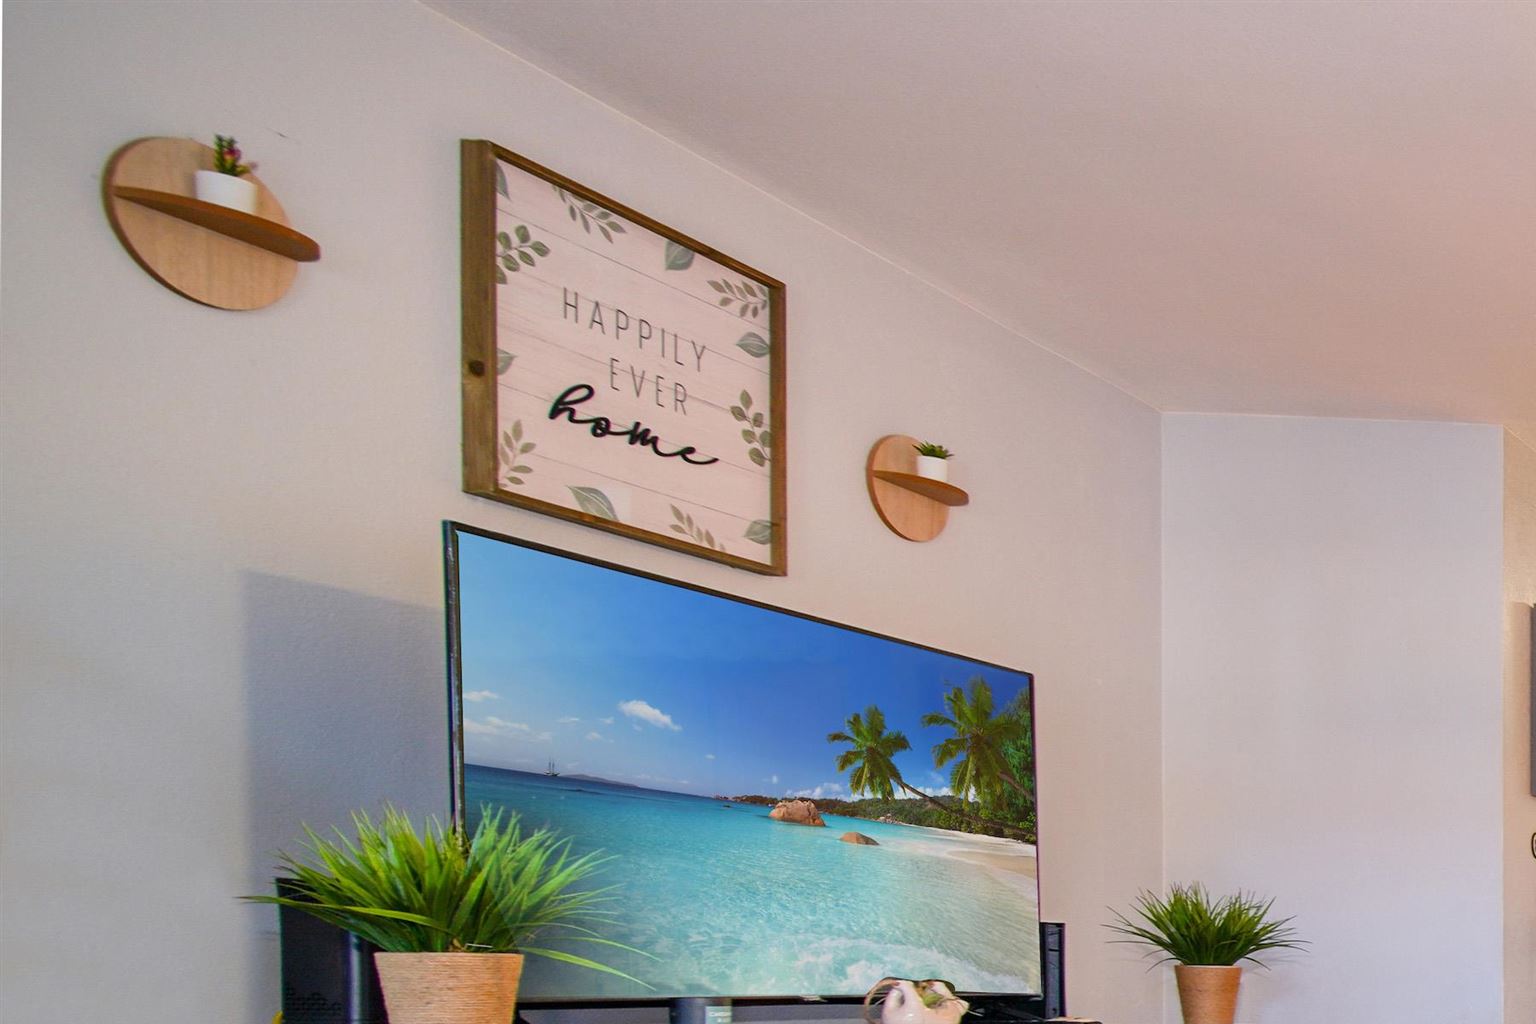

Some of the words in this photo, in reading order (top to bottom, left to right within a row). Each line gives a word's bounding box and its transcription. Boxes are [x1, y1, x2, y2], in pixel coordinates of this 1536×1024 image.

[562, 287, 706, 372] HAPPILY
[547, 383, 719, 465] home
[609, 357, 688, 415] EVER
